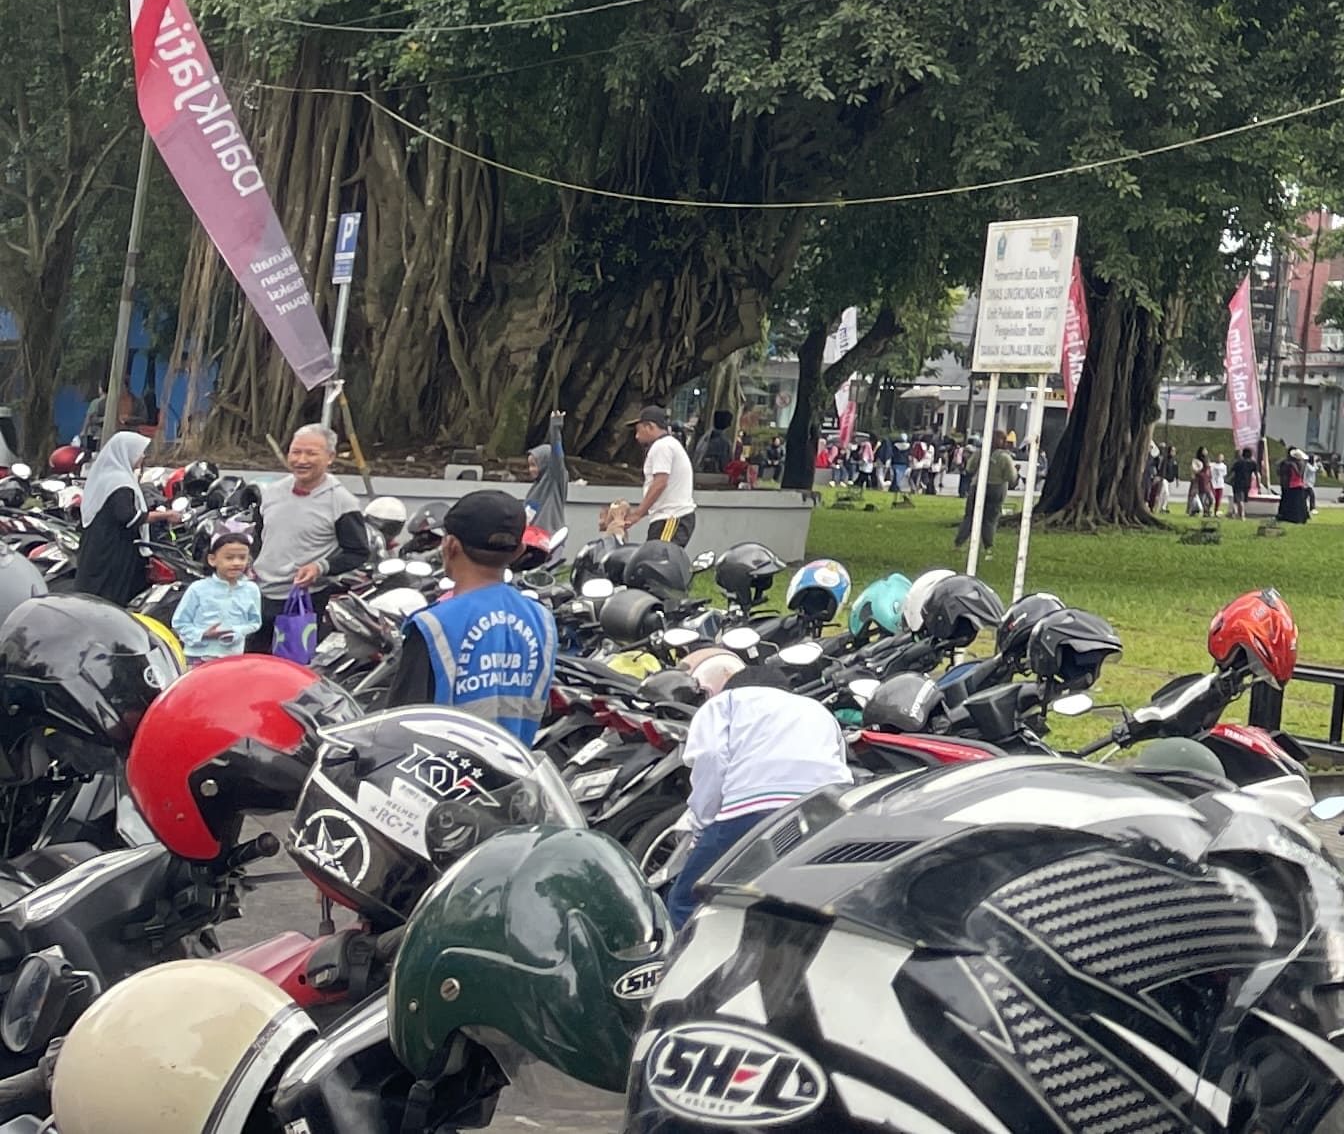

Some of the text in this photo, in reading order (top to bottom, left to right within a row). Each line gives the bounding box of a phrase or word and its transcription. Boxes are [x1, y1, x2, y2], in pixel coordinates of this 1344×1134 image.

[341, 216, 355, 251] P
[456, 610, 539, 677] PETUGAS PARKIR
